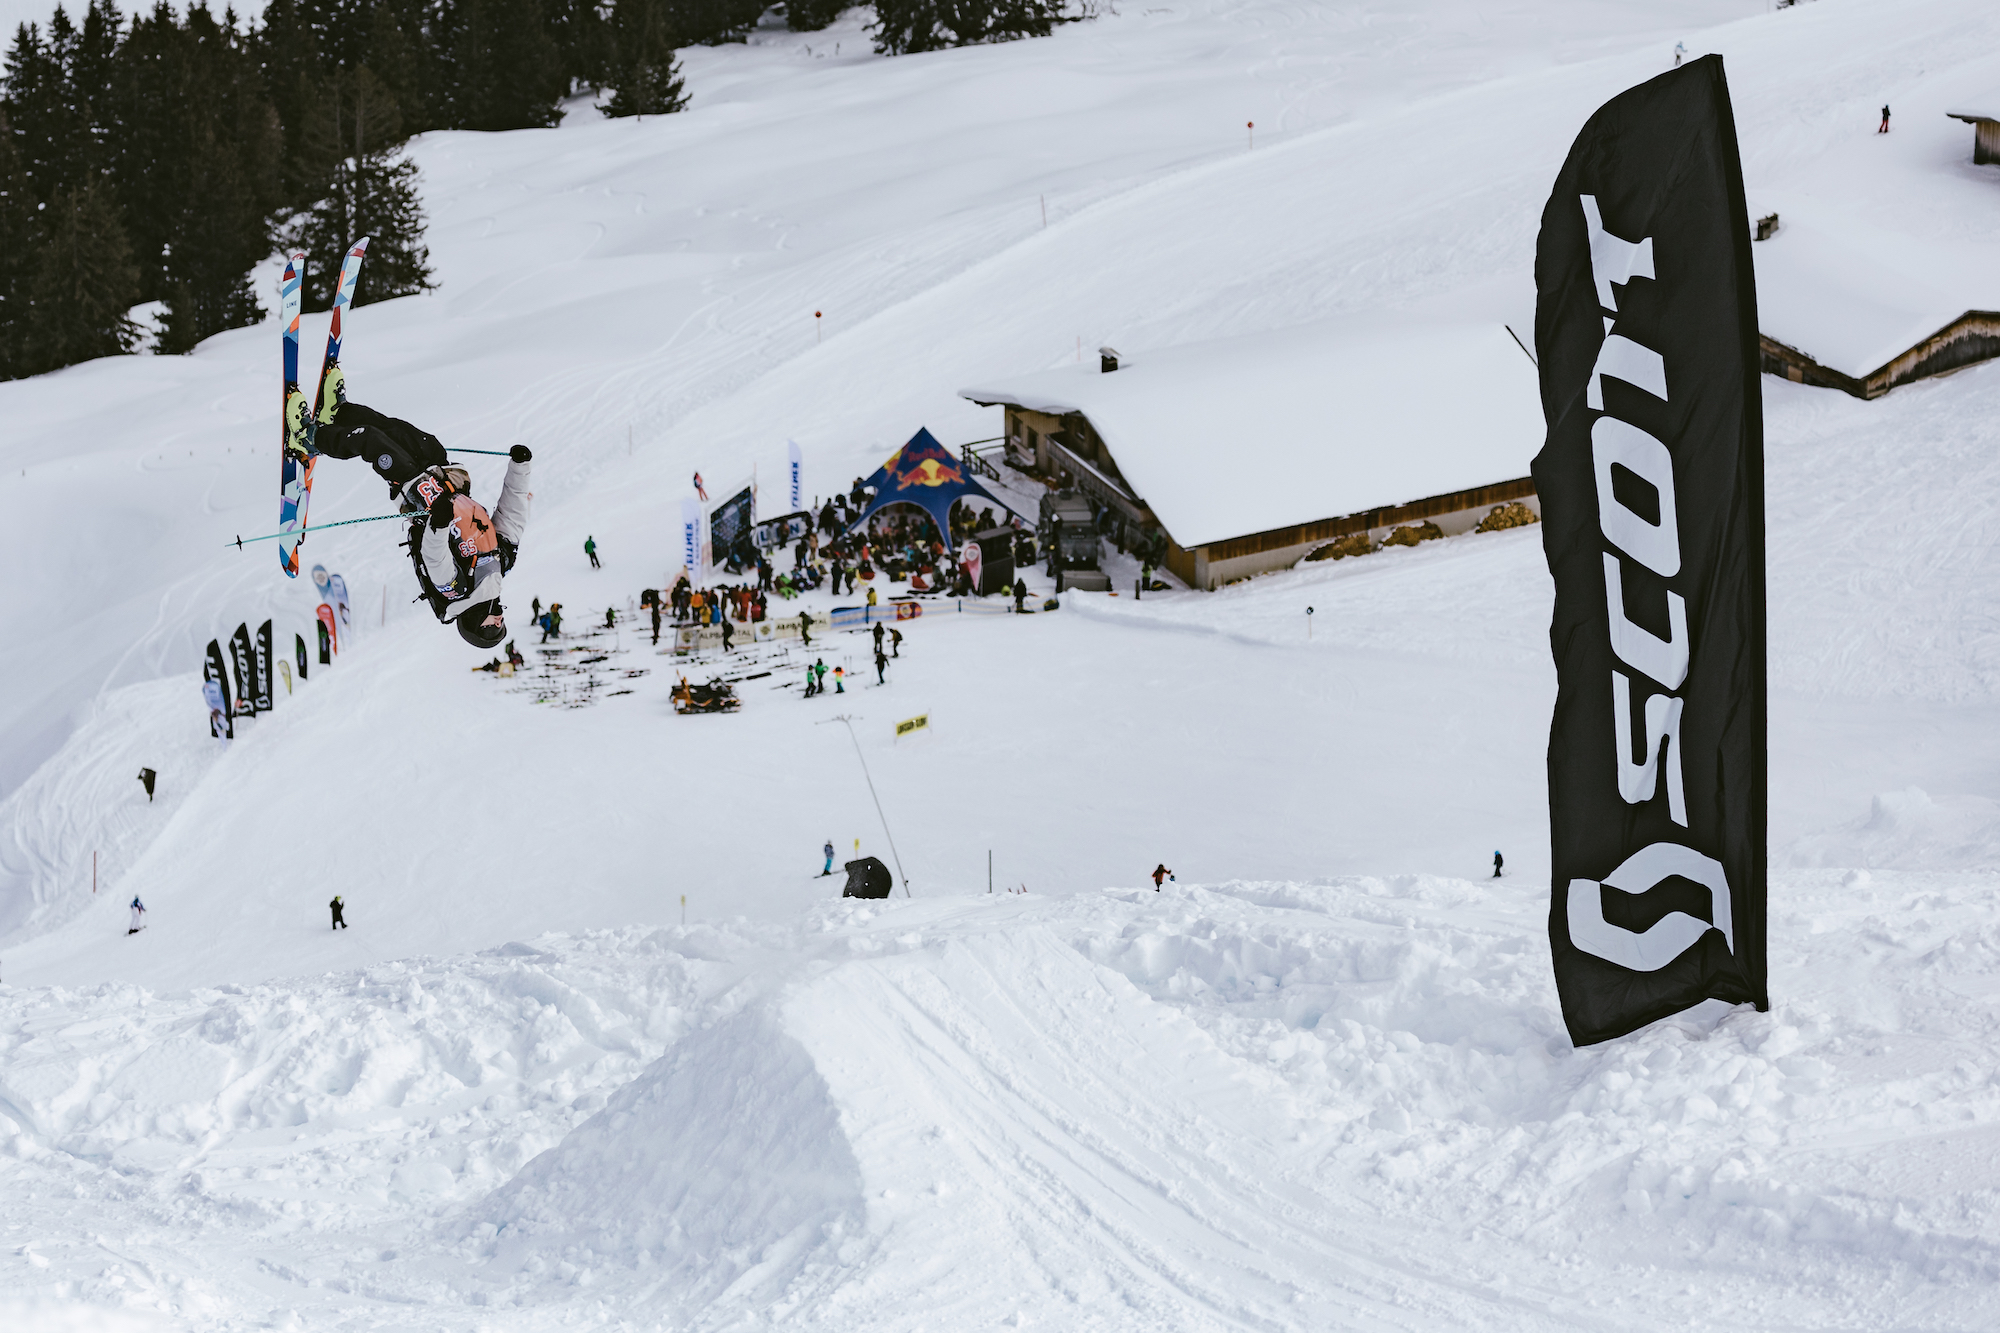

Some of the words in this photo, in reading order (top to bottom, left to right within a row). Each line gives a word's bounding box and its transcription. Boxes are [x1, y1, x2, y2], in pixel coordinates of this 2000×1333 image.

[286, 299, 297, 309] LINE
[908, 448, 928, 462] Red
[928, 447, 946, 459] Bull
[1580, 194, 1689, 829] SCOTT
[458, 538, 477, 557] 53
[232, 637, 249, 700] SCOTT
